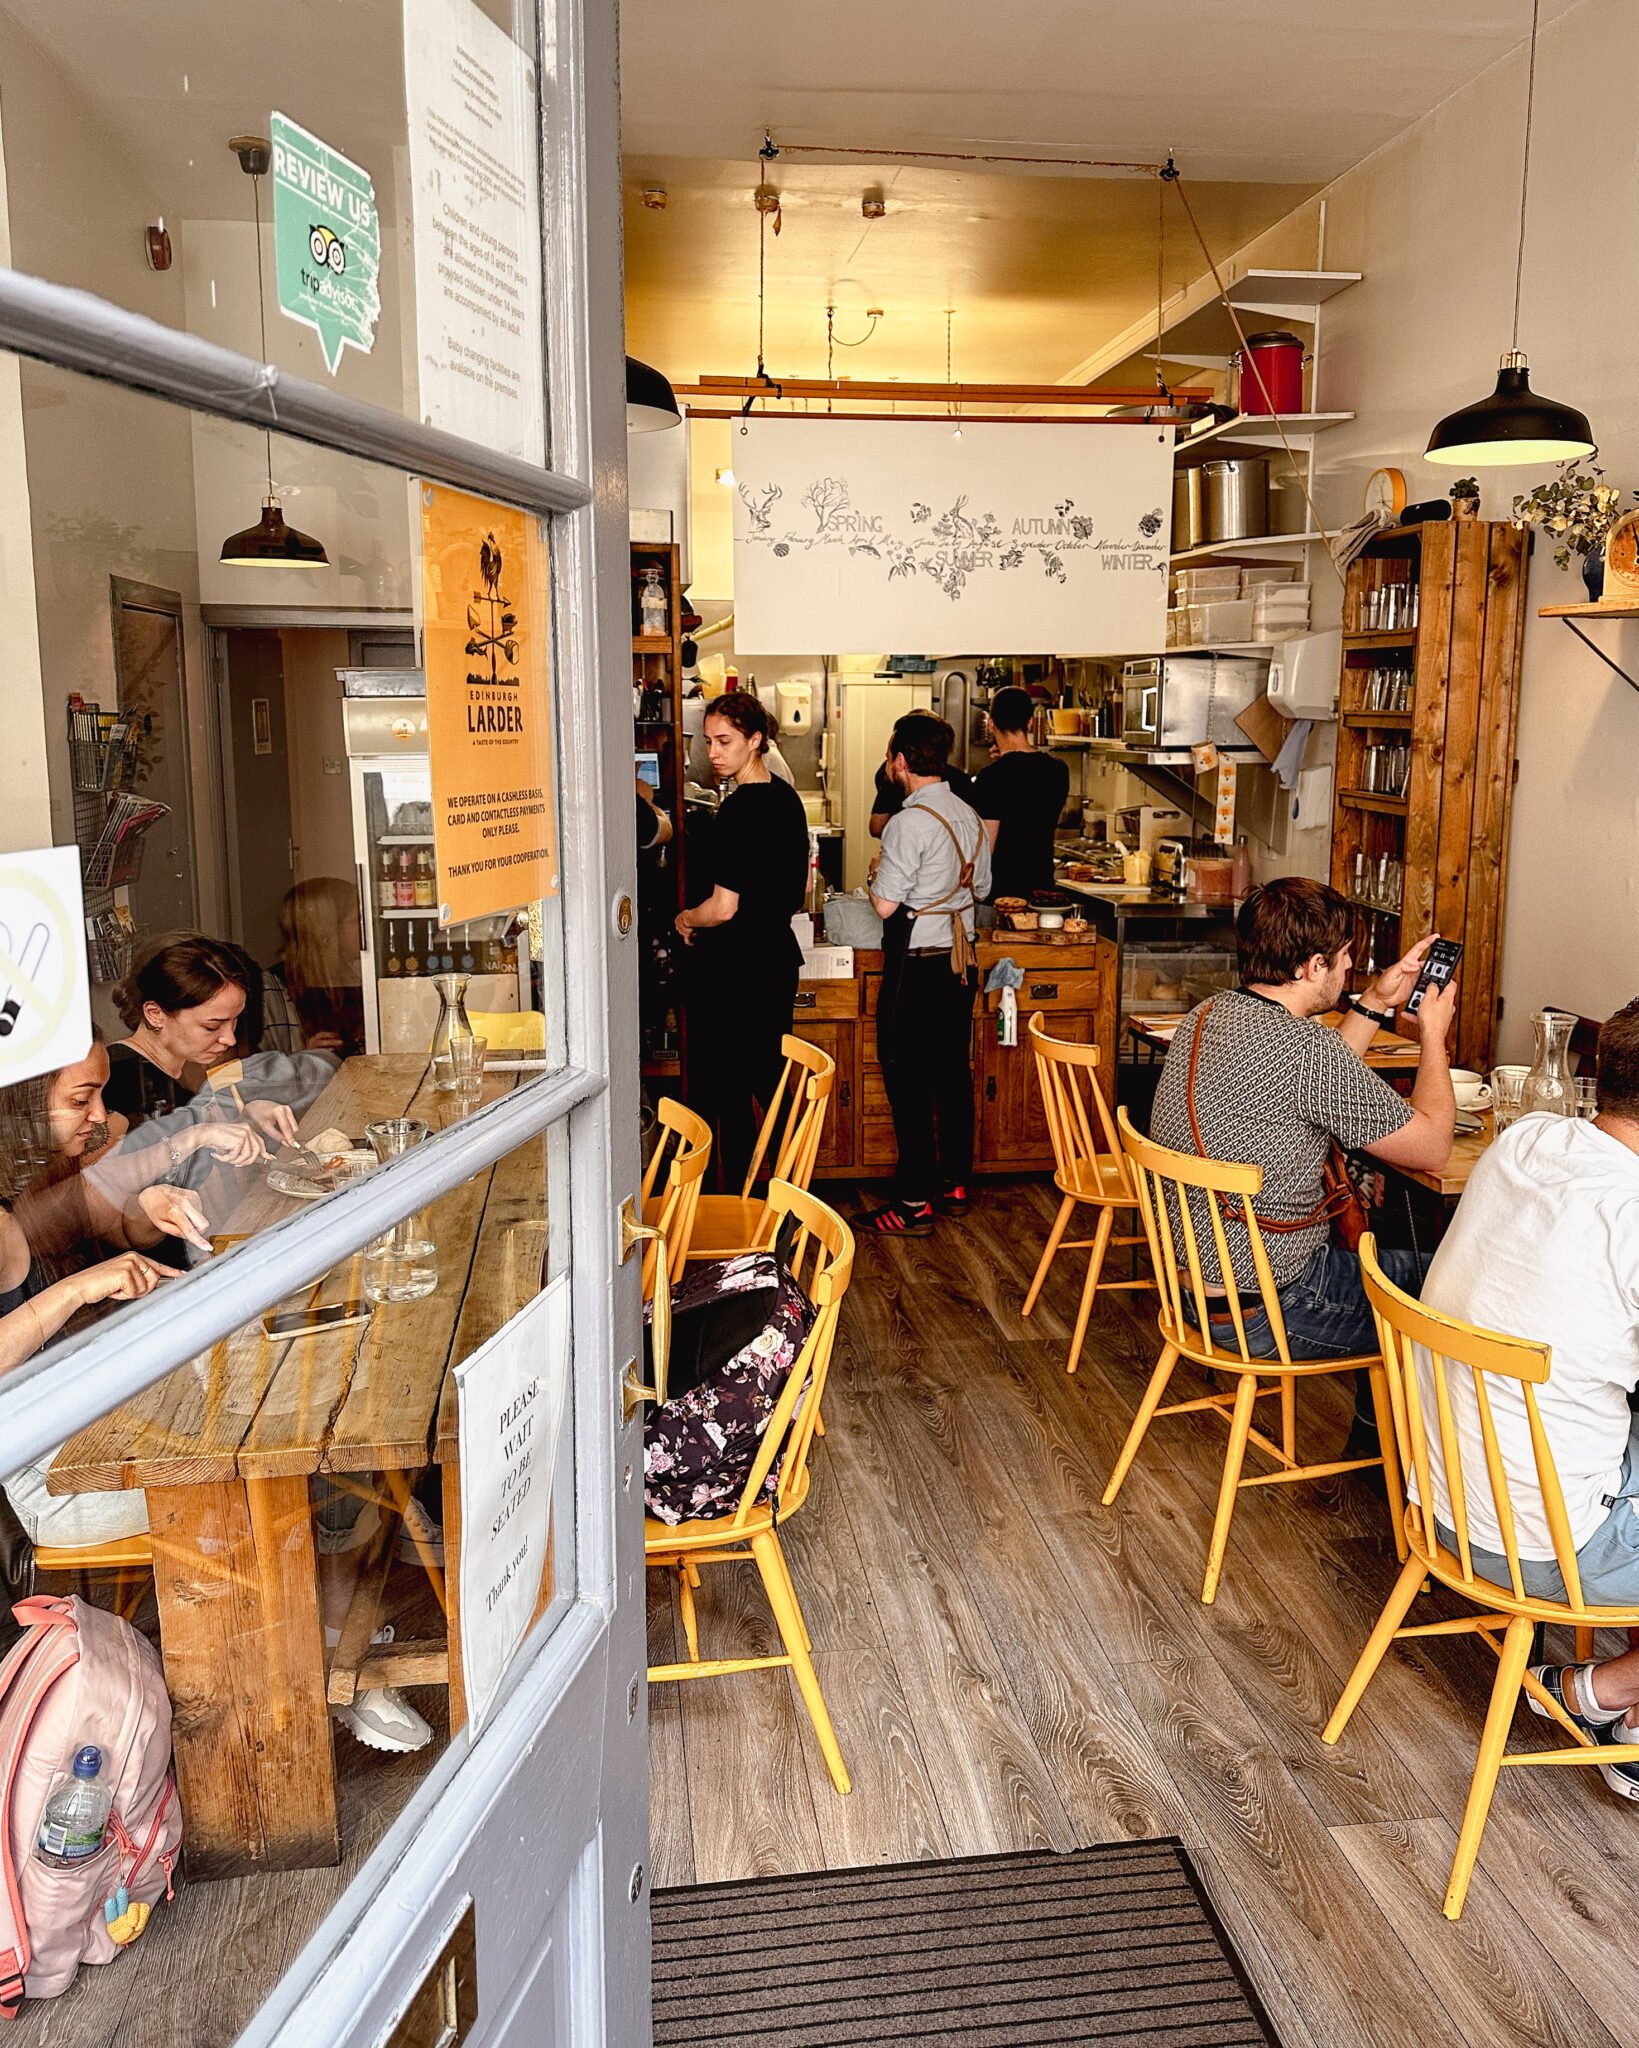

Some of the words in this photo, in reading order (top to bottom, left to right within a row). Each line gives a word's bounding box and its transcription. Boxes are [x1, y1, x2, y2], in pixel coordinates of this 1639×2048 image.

[274, 145, 343, 210] REVIEW
[348, 193, 370, 228] US
[469, 222, 479, 237] and
[481, 230, 497, 251] young
[455, 253, 476, 273] allowed
[478, 267, 484, 277] on
[496, 259, 505, 272] and
[301, 267, 356, 309] tripadvisor
[465, 279, 485, 297] children
[444, 286, 453, 299] are
[455, 292, 491, 320] accompanied
[492, 312, 498, 327] by
[448, 336, 462, 356] Baby
[464, 346, 489, 370] changing
[450, 360, 475, 380] available
[477, 373, 483, 382] on
[828, 515, 882, 532] SPRING
[1012, 518, 1070, 535] AUTUMN
[936, 551, 993, 568] SUMMER
[1101, 554, 1152, 570] WINTER
[470, 690, 518, 702] EDINBURGH
[467, 705, 523, 732] LARDER
[447, 797, 458, 808] WE
[459, 794, 486, 808] OPERATE
[487, 793, 496, 804] ON
[497, 793, 501, 802] A
[502, 789, 528, 803] CASHLESS
[528, 788, 543, 800] BASIS,
[447, 813, 466, 826] CARD
[467, 812, 480, 824] AND
[481, 807, 519, 822] CONTACTLESS
[520, 803, 545, 816] PAYMENTS
[482, 825, 498, 838] ONLY
[498, 823, 519, 836] PLEASE.
[448, 863, 471, 878] THANK
[471, 861, 484, 874] YOU
[484, 858, 496, 871] FOR
[496, 855, 512, 868] YOUR
[513, 848, 549, 864] COOPERATION.
[500, 1376, 540, 1436] PLEASE
[504, 1414, 534, 1461] WAIT
[501, 1468, 517, 1499] TO
[518, 1447, 533, 1479] BE
[491, 1476, 531, 1541] SEATED
[486, 1564, 511, 1613] Thank
[513, 1534, 528, 1577] you!
